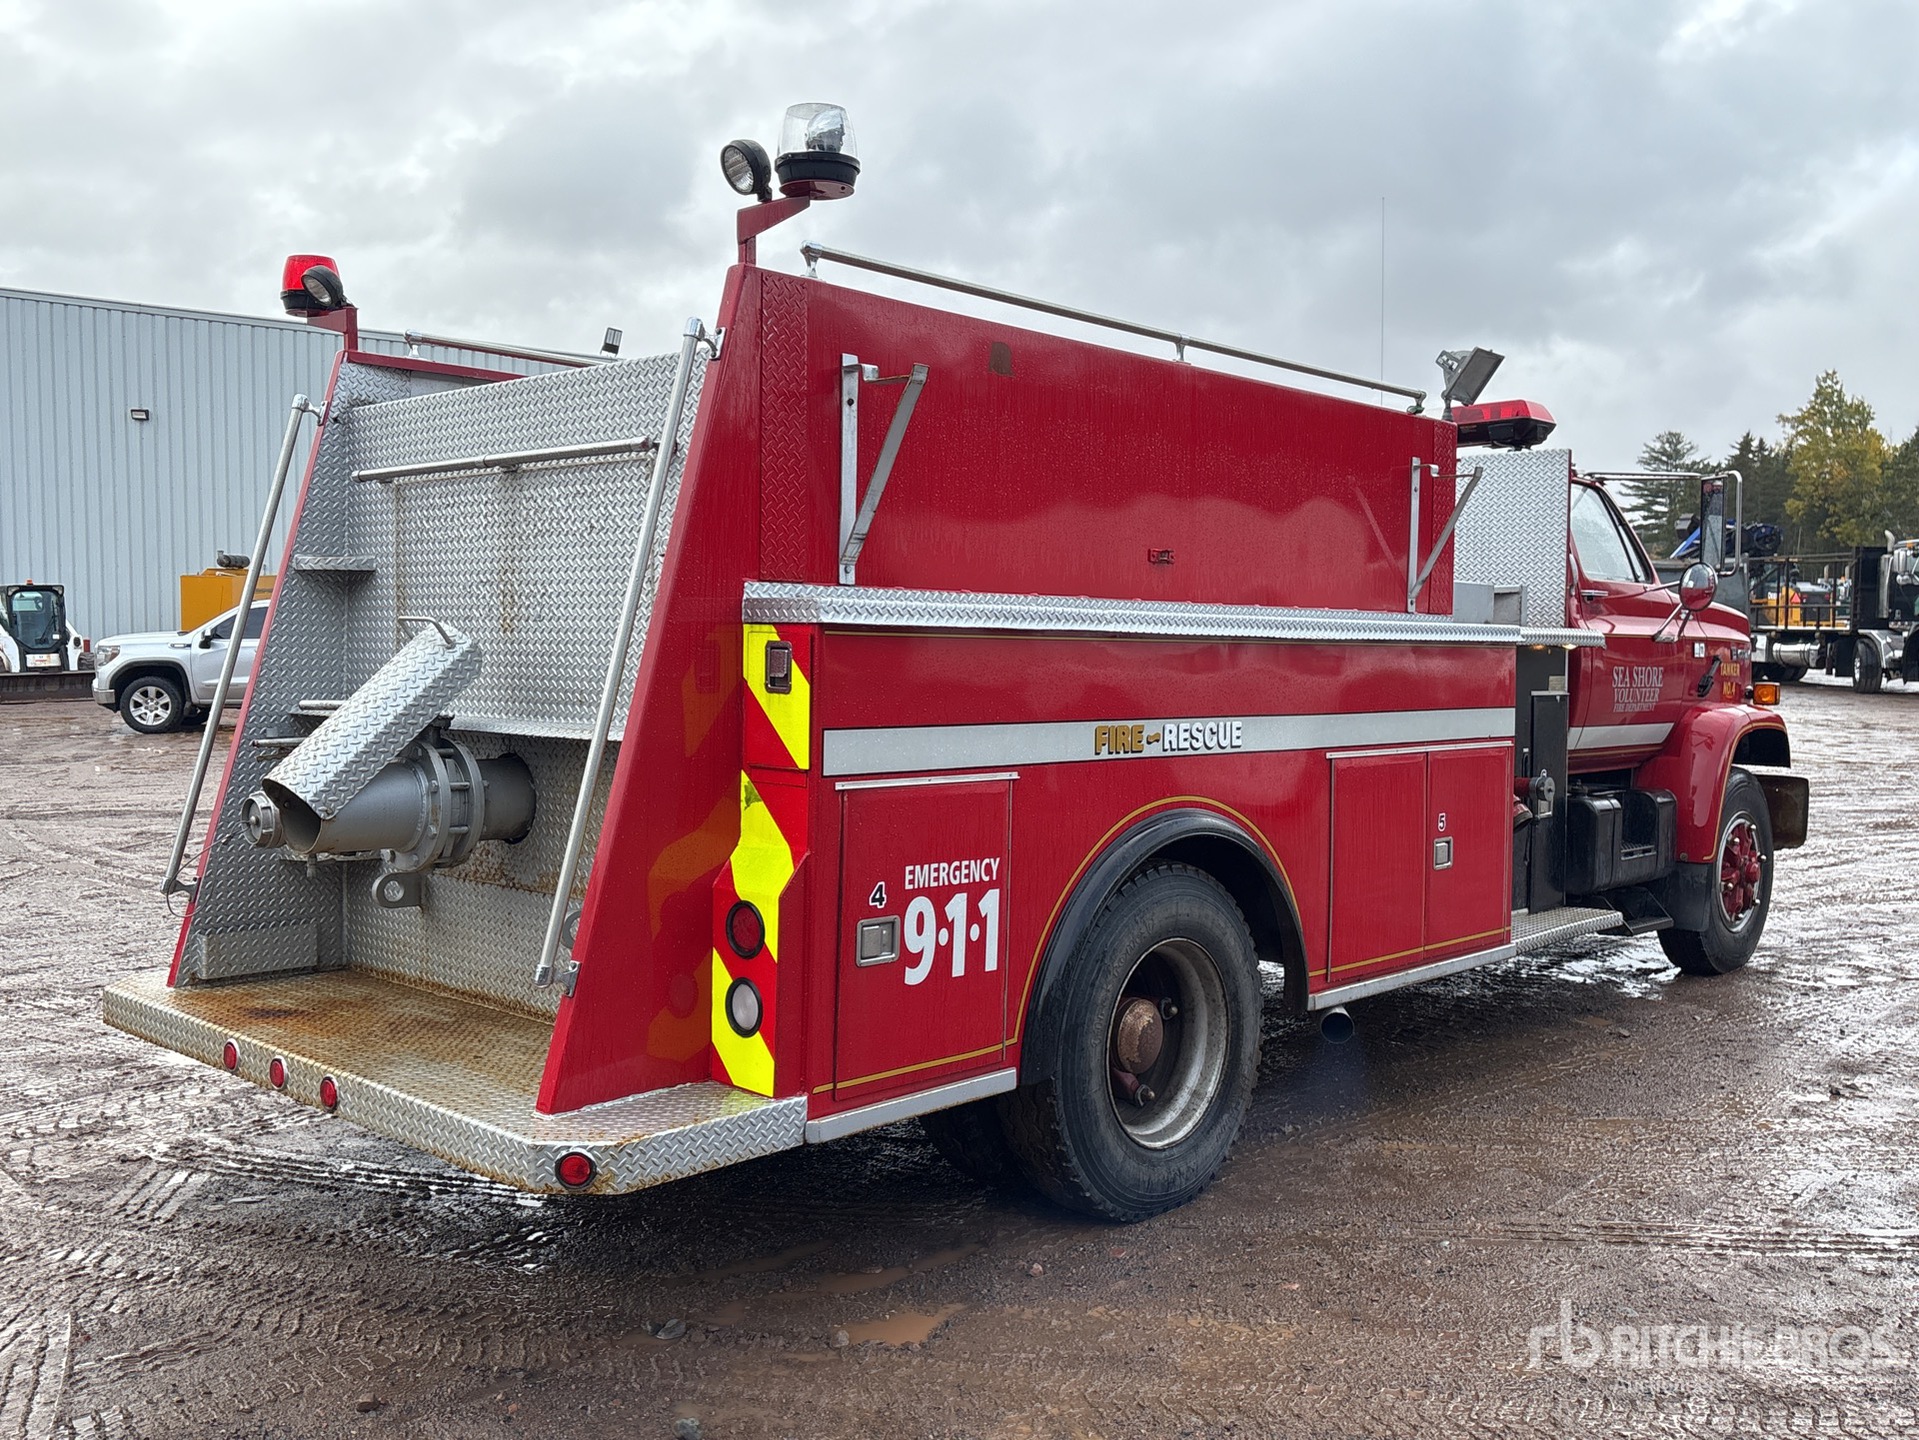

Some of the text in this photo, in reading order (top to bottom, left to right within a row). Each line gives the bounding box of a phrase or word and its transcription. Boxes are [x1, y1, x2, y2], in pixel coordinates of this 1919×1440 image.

[1612, 666, 1664, 688] SEA SHORE
[1614, 688, 1660, 703] VOLUNTEER
[1438, 812, 1446, 832] 5
[904, 857, 1000, 890] EMERGENCY
[869, 881, 887, 909] 4
